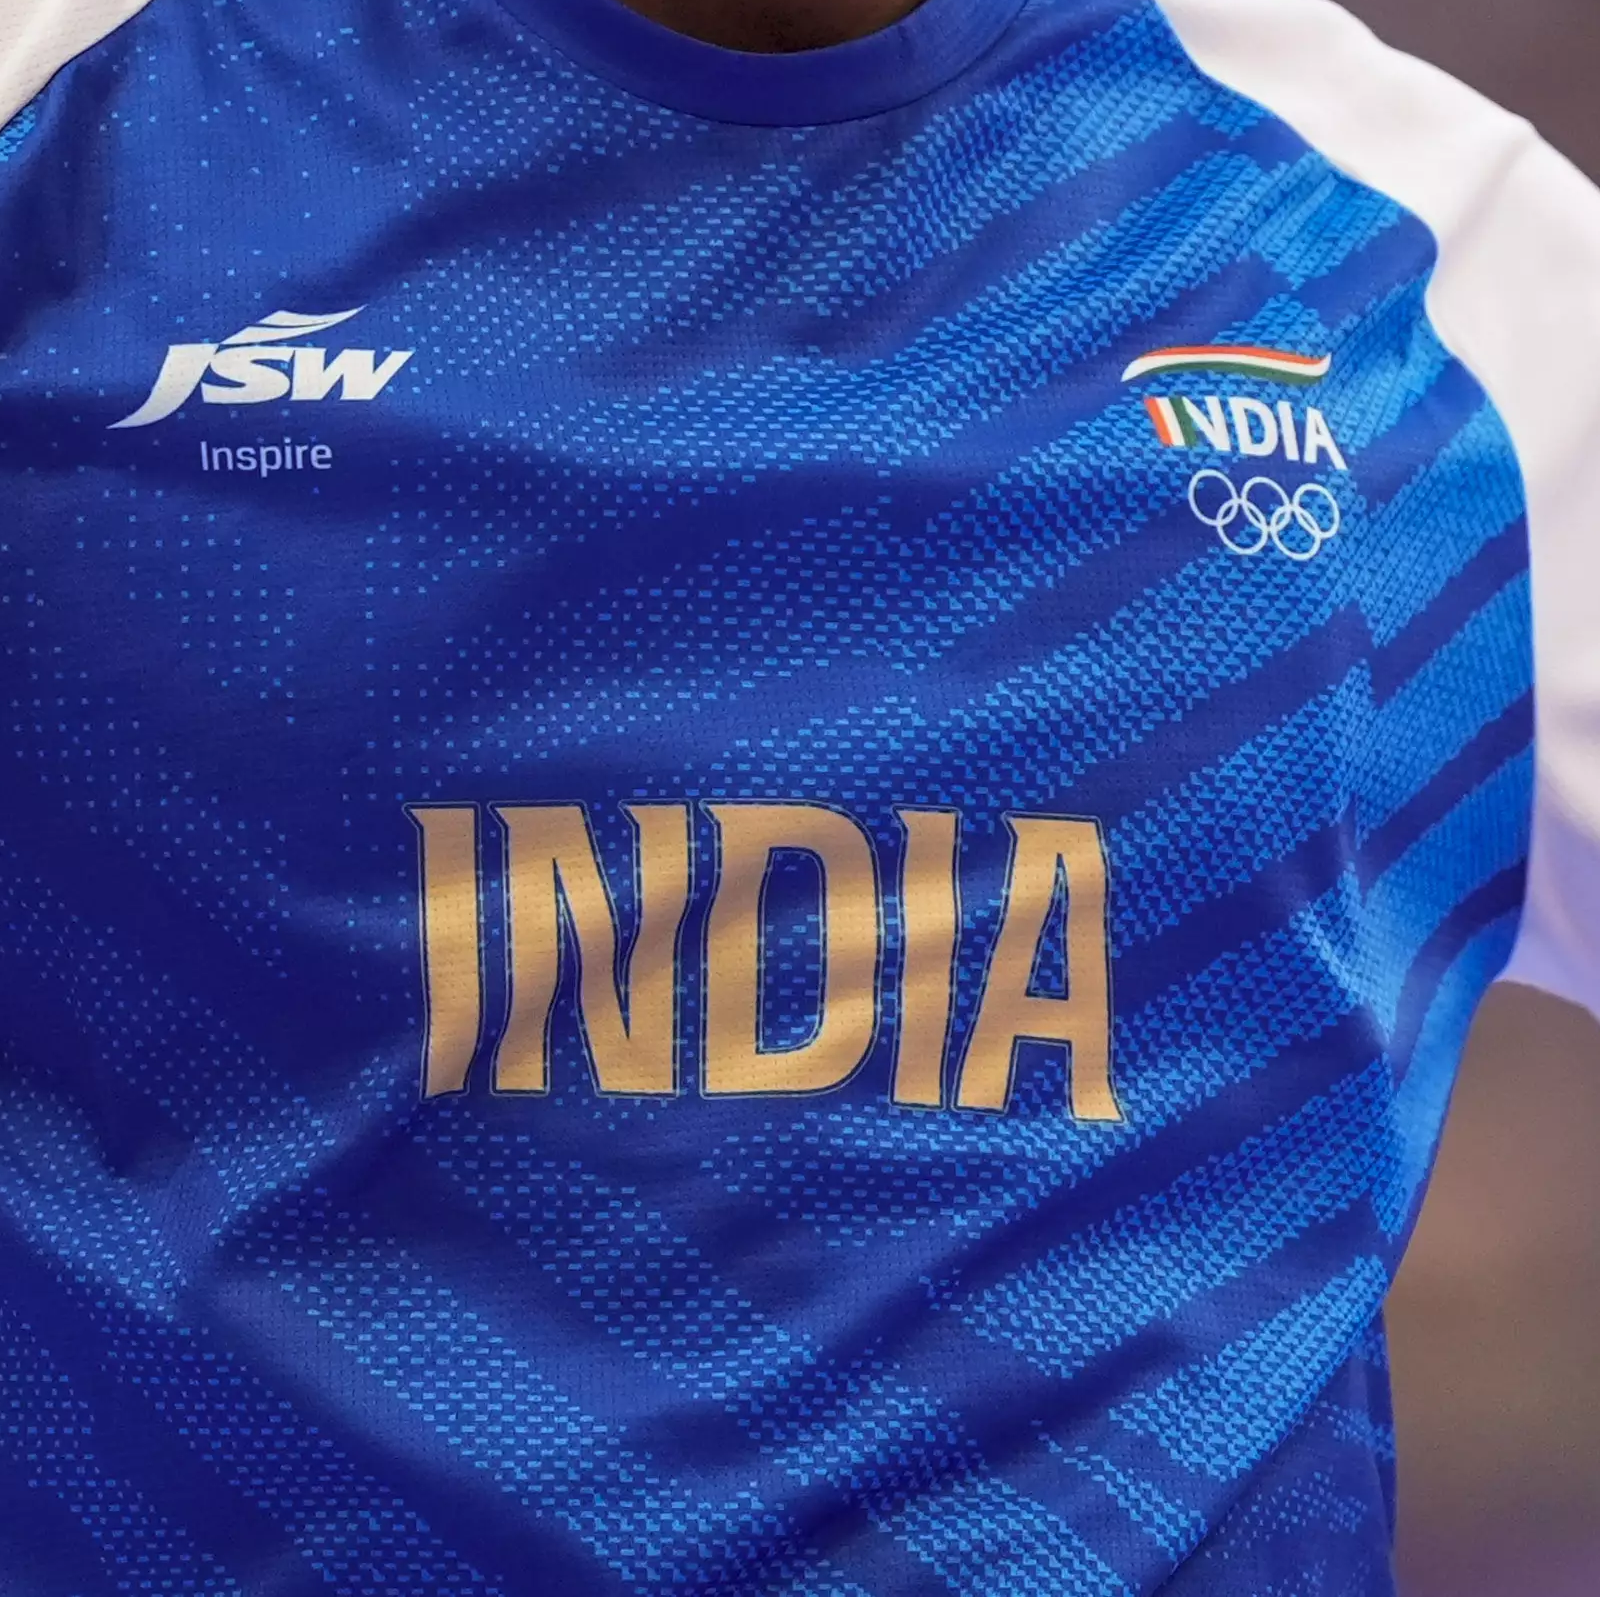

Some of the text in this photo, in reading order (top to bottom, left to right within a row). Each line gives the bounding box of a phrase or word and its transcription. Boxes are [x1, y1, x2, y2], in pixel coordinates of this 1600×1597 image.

[106, 343, 416, 429] JSW
[200, 438, 333, 478] Inspire
[1143, 396, 1348, 470] INDIA
[403, 800, 1127, 1124] INDIA
